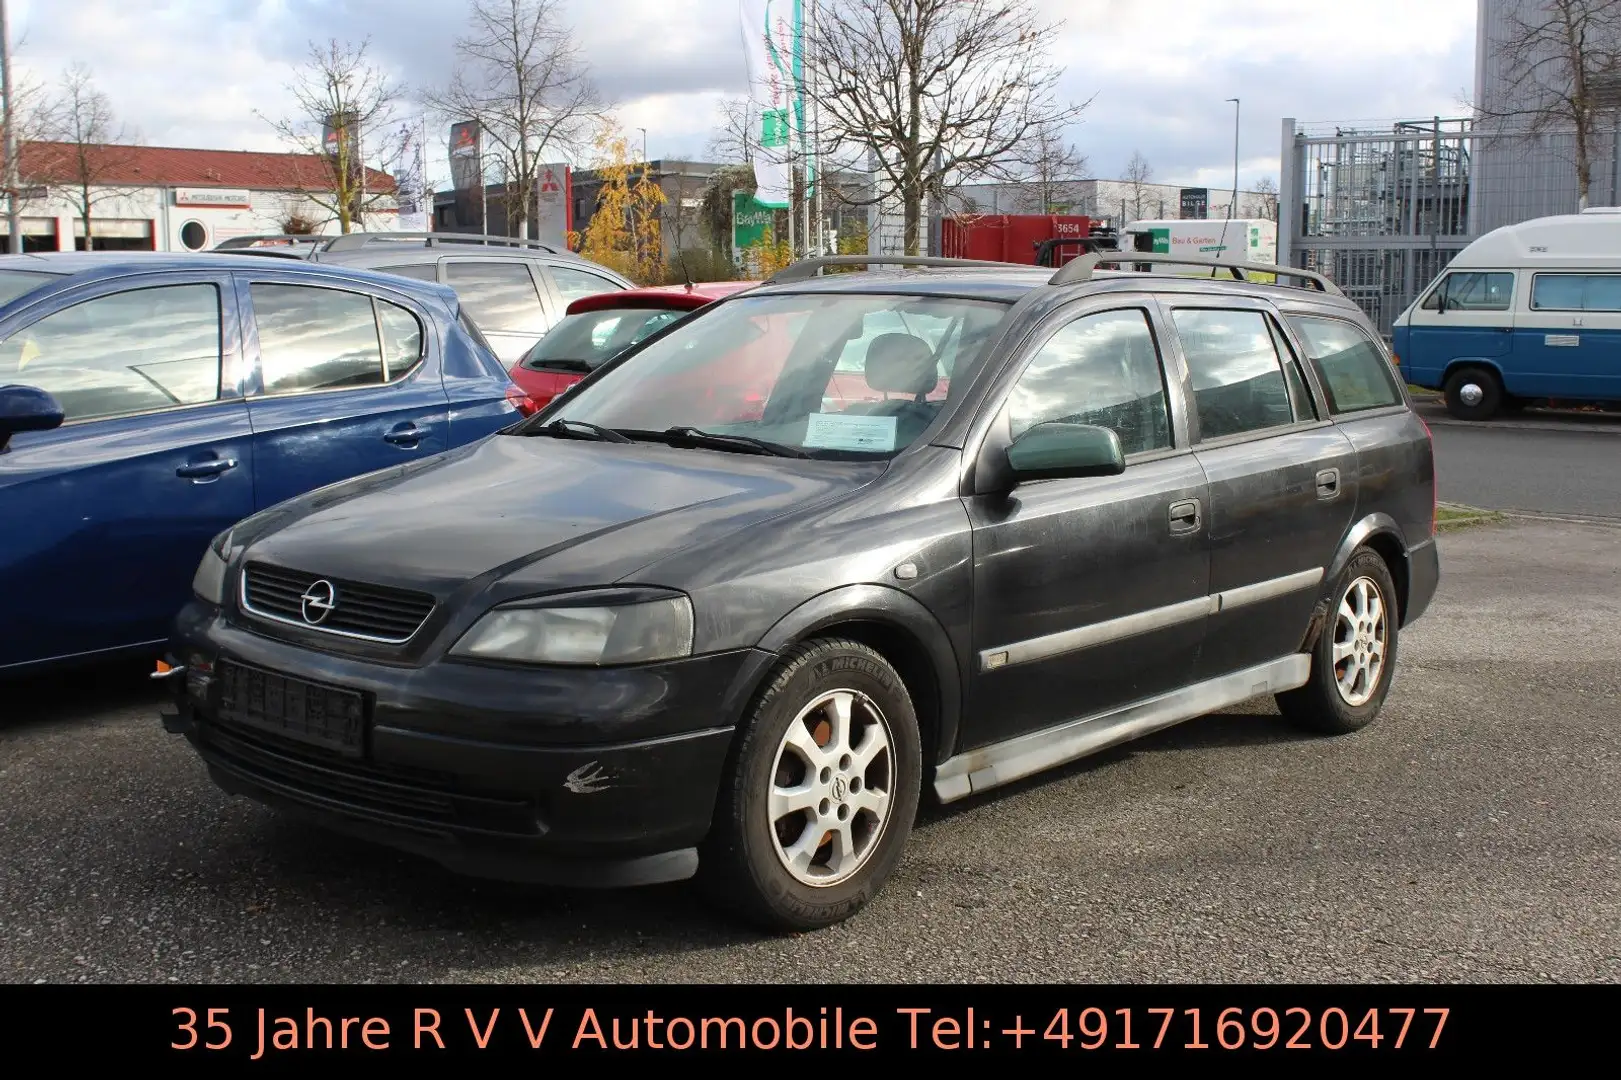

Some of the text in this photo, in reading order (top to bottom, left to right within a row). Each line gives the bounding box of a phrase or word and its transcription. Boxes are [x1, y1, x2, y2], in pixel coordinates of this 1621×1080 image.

[736, 211, 772, 227] BayWa
[1057, 223, 1080, 233] 3654
[1172, 237, 1185, 245] Bau
[1193, 236, 1217, 245] Garten
[831, 656, 892, 688] MICHELIN
